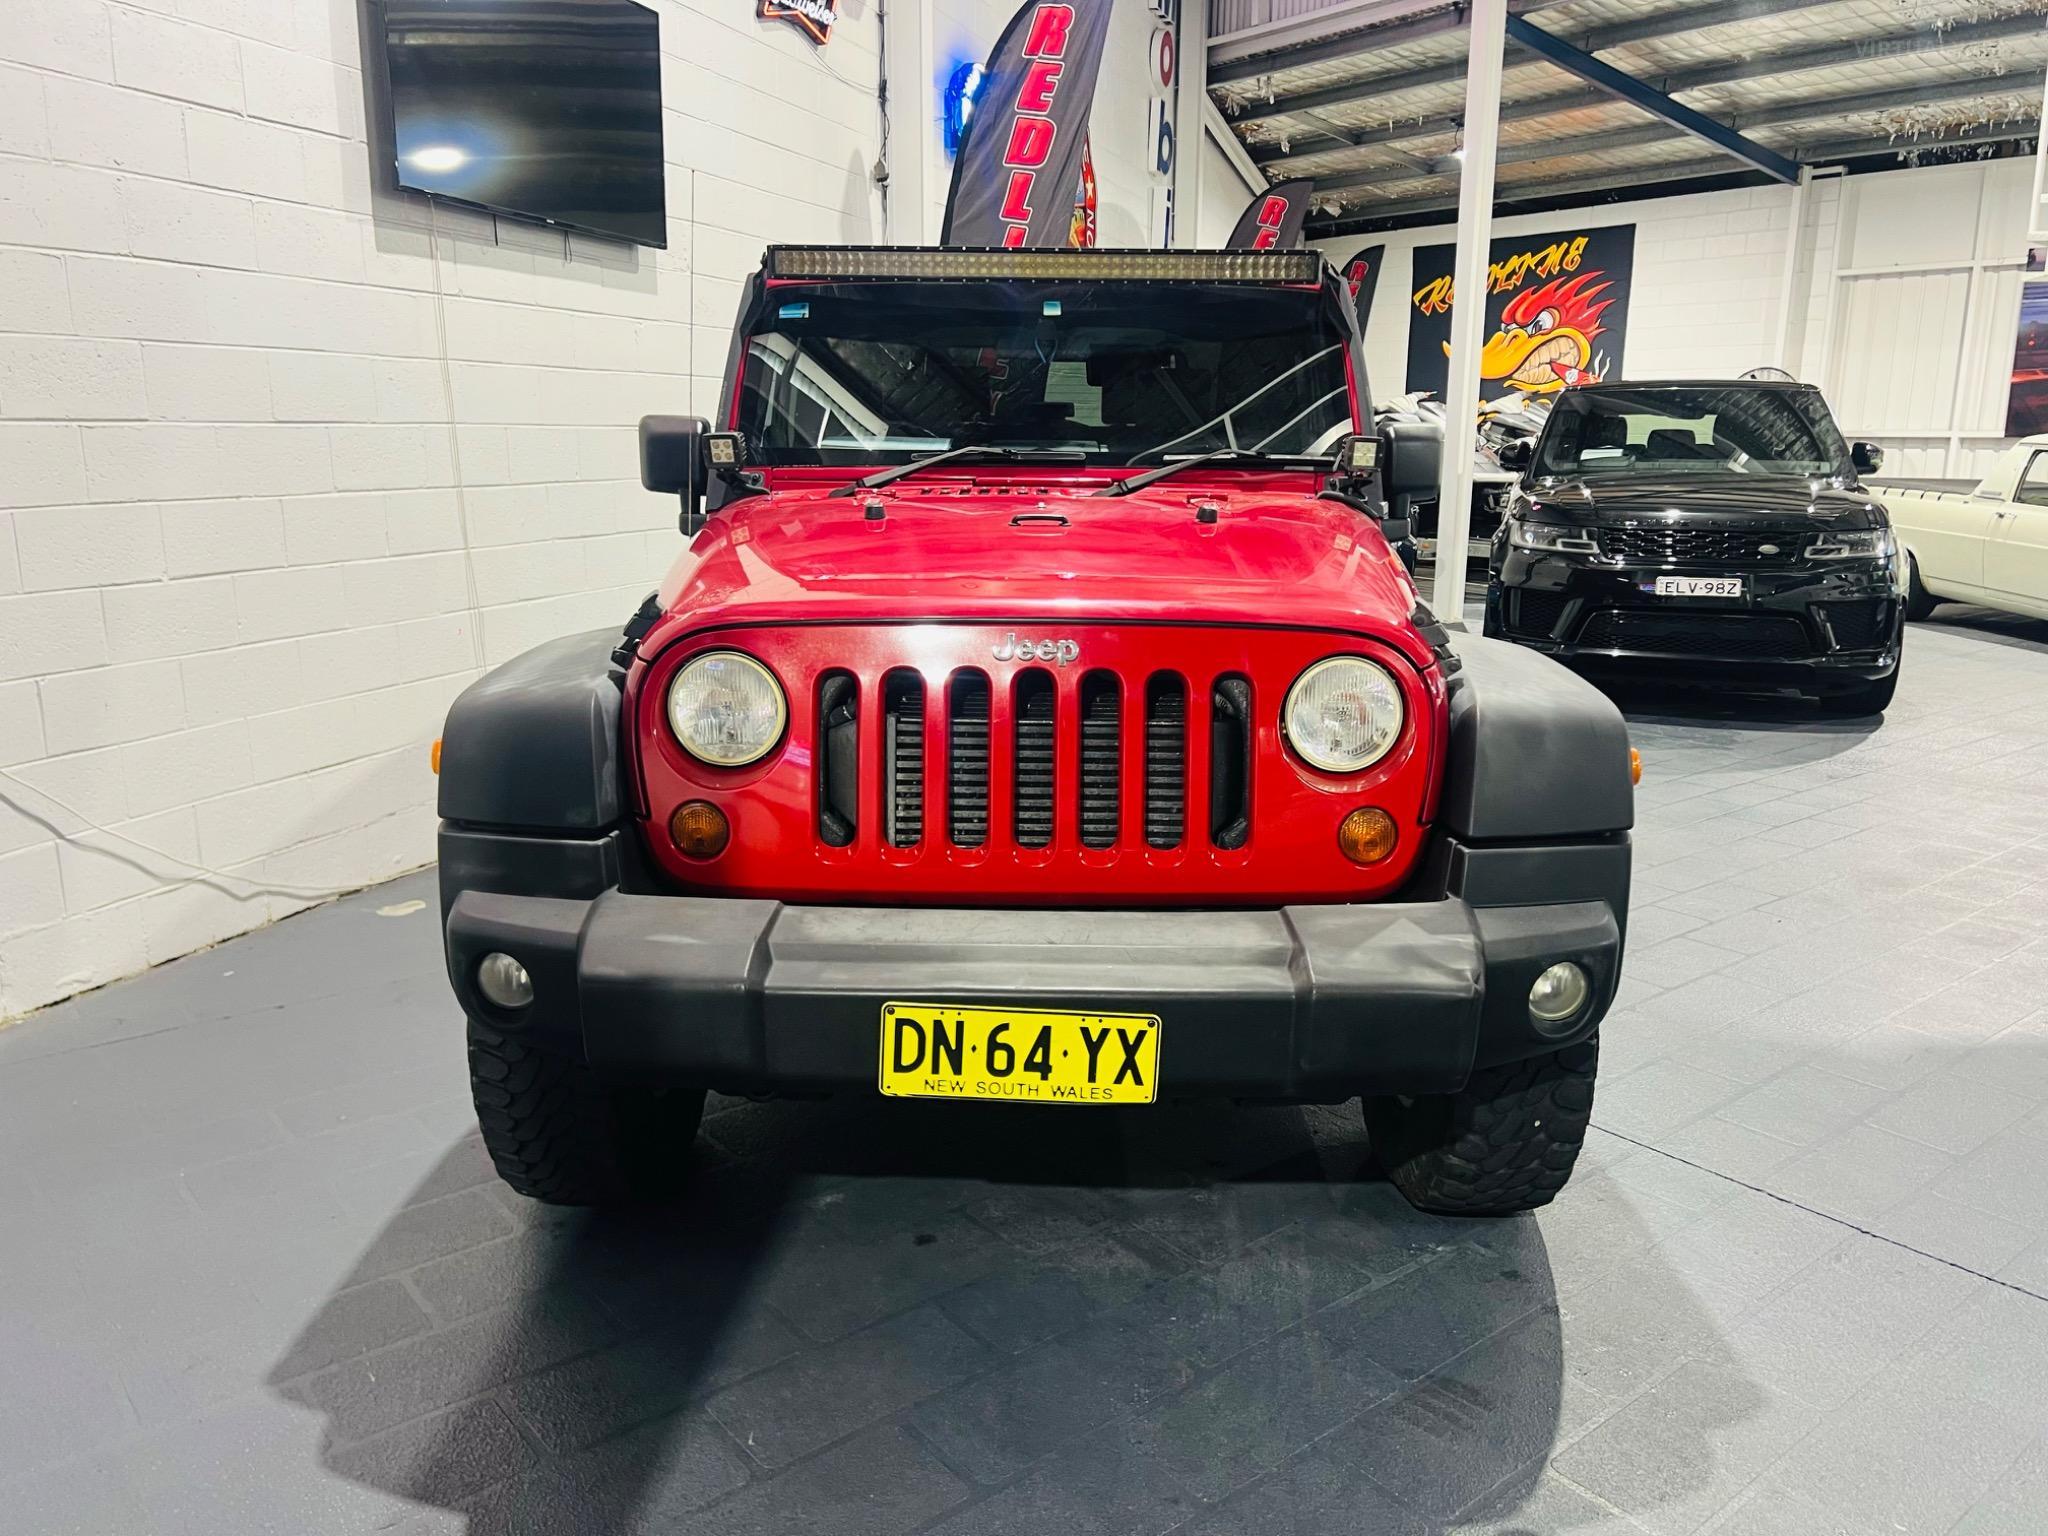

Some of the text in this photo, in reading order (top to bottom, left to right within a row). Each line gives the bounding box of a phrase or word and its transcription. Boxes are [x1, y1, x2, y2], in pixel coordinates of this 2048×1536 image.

[1413, 236, 1589, 317] RLINE
[992, 632, 1080, 668] Jeep
[923, 1078, 1113, 1100] NEW SOUTH WALES
